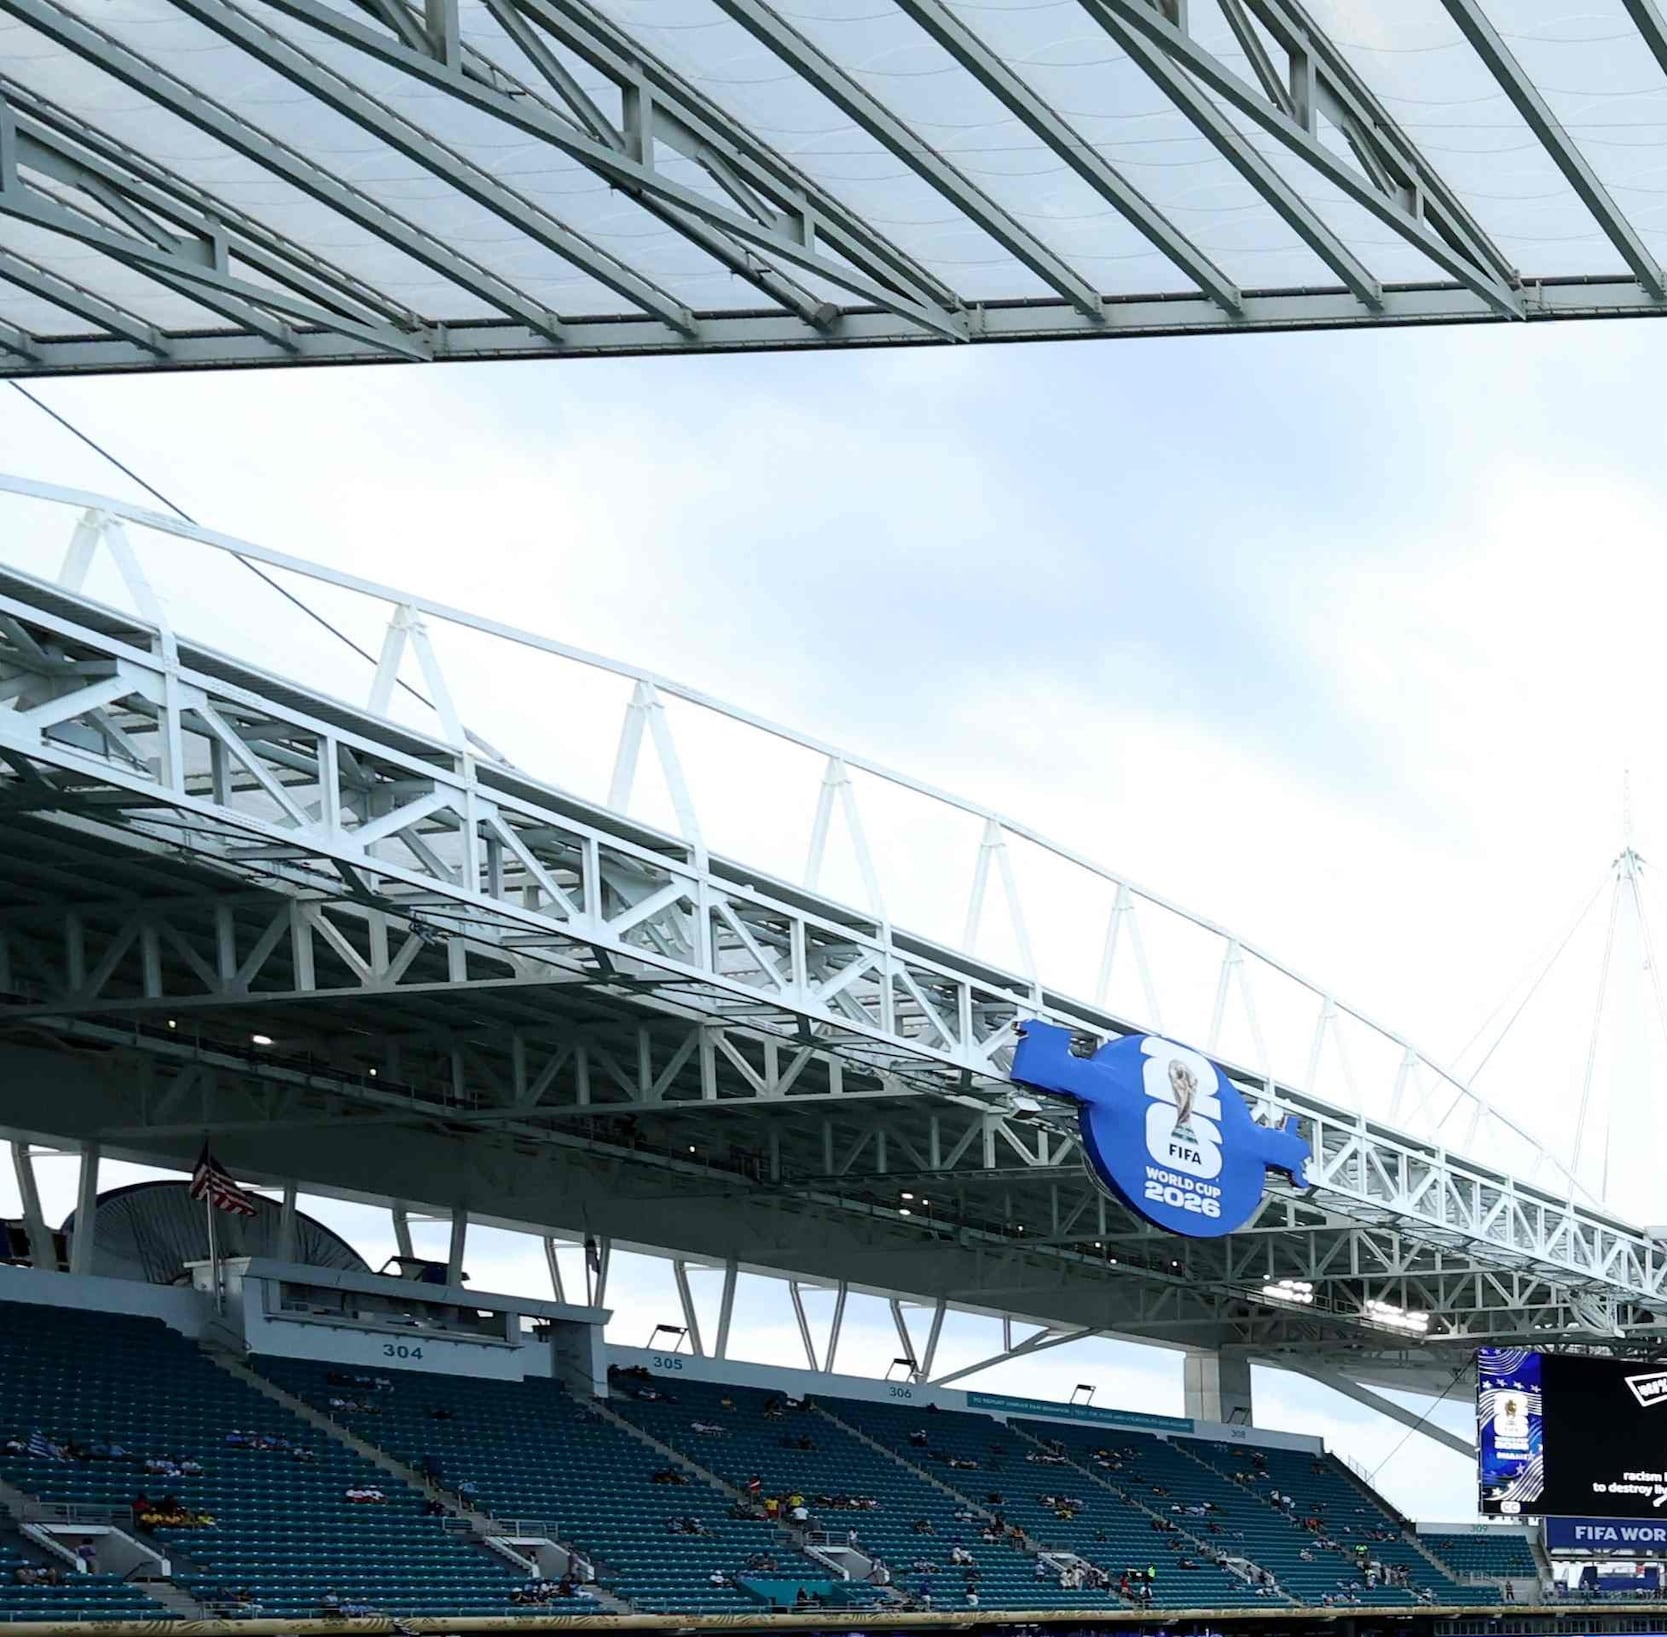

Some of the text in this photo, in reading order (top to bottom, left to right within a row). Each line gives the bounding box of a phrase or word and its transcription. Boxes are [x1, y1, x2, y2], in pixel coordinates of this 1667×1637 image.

[1169, 1143, 1202, 1165] FIFA
[1145, 1166, 1222, 1199] WORLD CUP
[1145, 1181, 1222, 1219] 2026
[383, 1344, 424, 1360] 304
[653, 1357, 683, 1370] 305
[889, 1387, 912, 1398] 306
[1623, 1472, 1662, 1482] racism
[1593, 1483, 1607, 1492] to
[1608, 1483, 1652, 1496] destroy
[1575, 1526, 1617, 1541] FIFA
